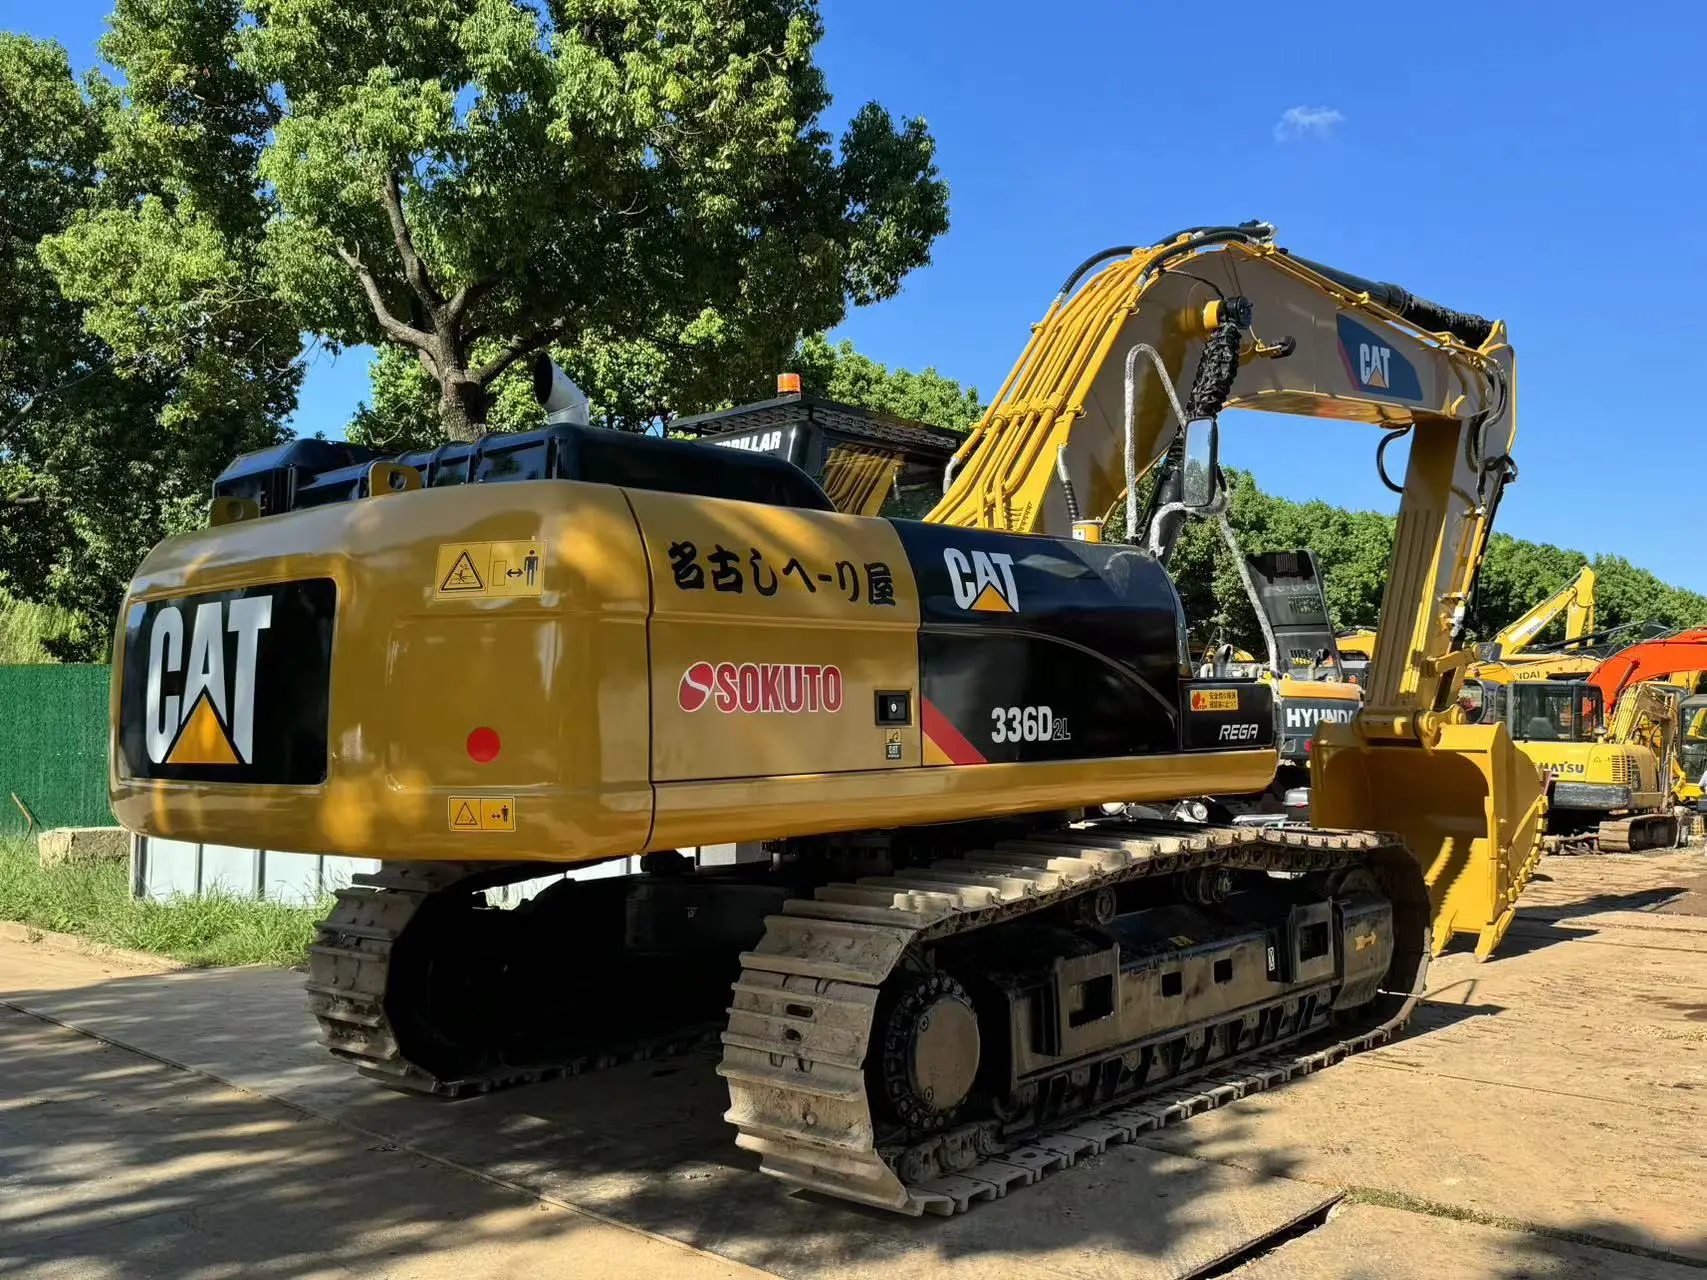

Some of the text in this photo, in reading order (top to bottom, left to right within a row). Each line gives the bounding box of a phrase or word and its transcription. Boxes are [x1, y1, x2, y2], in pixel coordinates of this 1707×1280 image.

[1360, 342, 1390, 389] CAT
[943, 547, 1020, 613] CAT
[146, 595, 273, 765] CAT
[714, 661, 843, 714] SOKUTO
[1219, 723, 1259, 741] REGA
